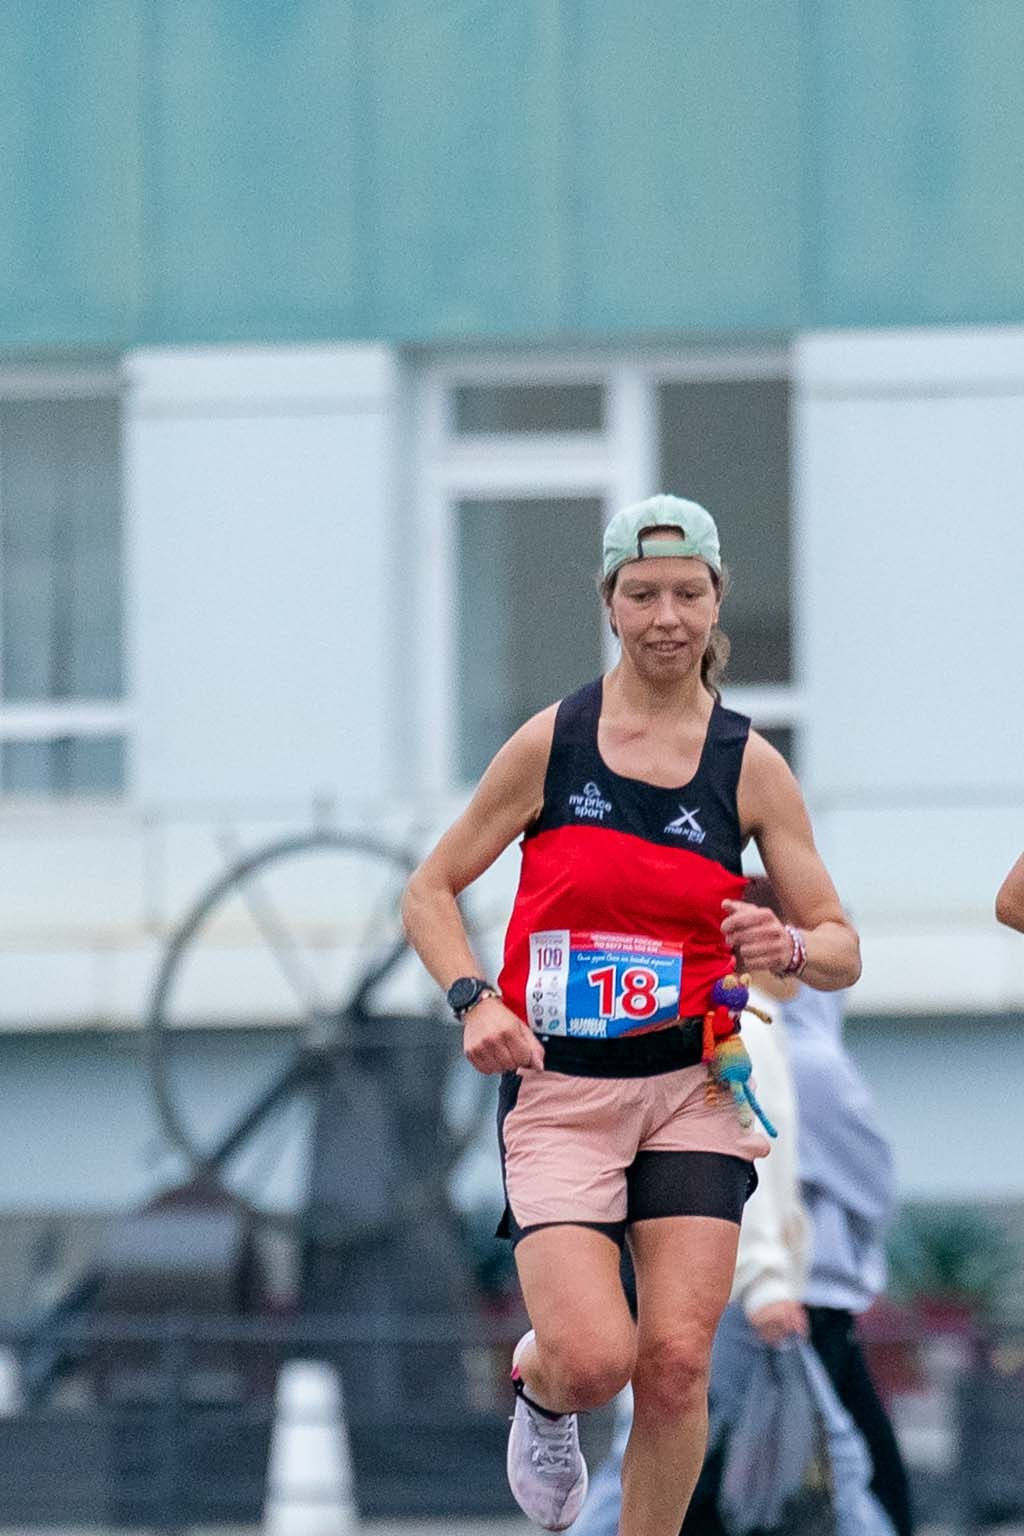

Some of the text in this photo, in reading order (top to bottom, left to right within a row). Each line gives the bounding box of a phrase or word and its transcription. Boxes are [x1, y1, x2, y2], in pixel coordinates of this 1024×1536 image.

[575, 805, 604, 820] sport
[538, 947, 562, 971] 100
[588, 964, 659, 1020] 18
